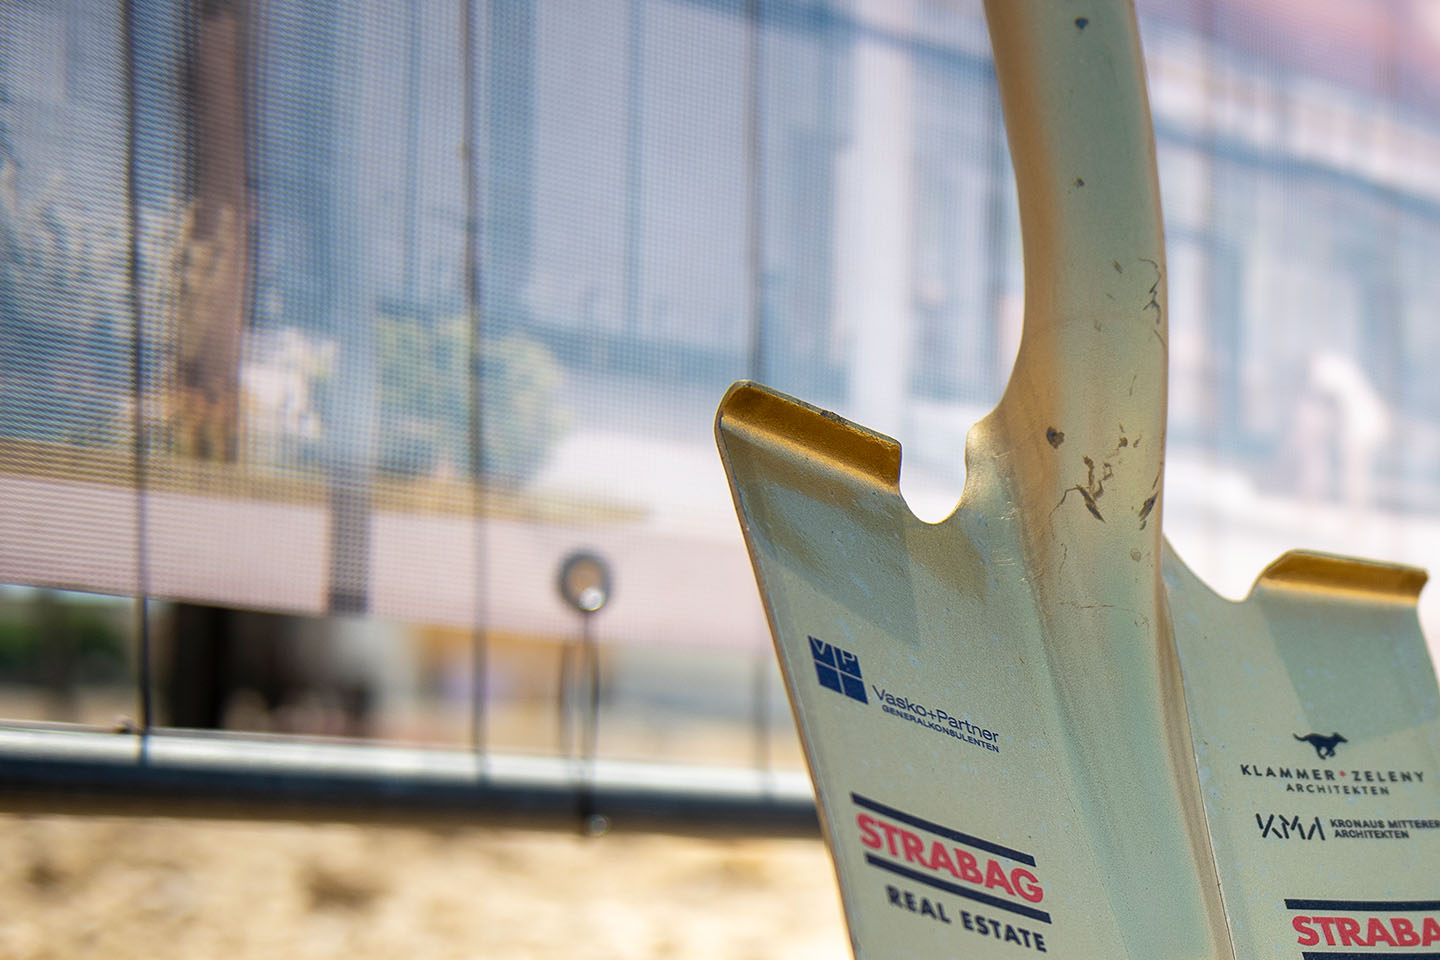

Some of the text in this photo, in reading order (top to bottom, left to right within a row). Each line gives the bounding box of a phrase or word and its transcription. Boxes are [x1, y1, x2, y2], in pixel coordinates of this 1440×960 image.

[872, 684, 1000, 743] Vasko+Partner
[882, 704, 1001, 753] GENERALKONSULENTEN
[1240, 764, 1425, 783] KLAMMER ZELENY
[1286, 783, 1390, 796] ARCHITEKTEN
[1330, 818, 1385, 829] KRONAUS
[1334, 829, 1410, 840] ARCHITEKTEN
[856, 812, 1044, 904] STRABAG
[885, 884, 1048, 954] REAL ESTATE
